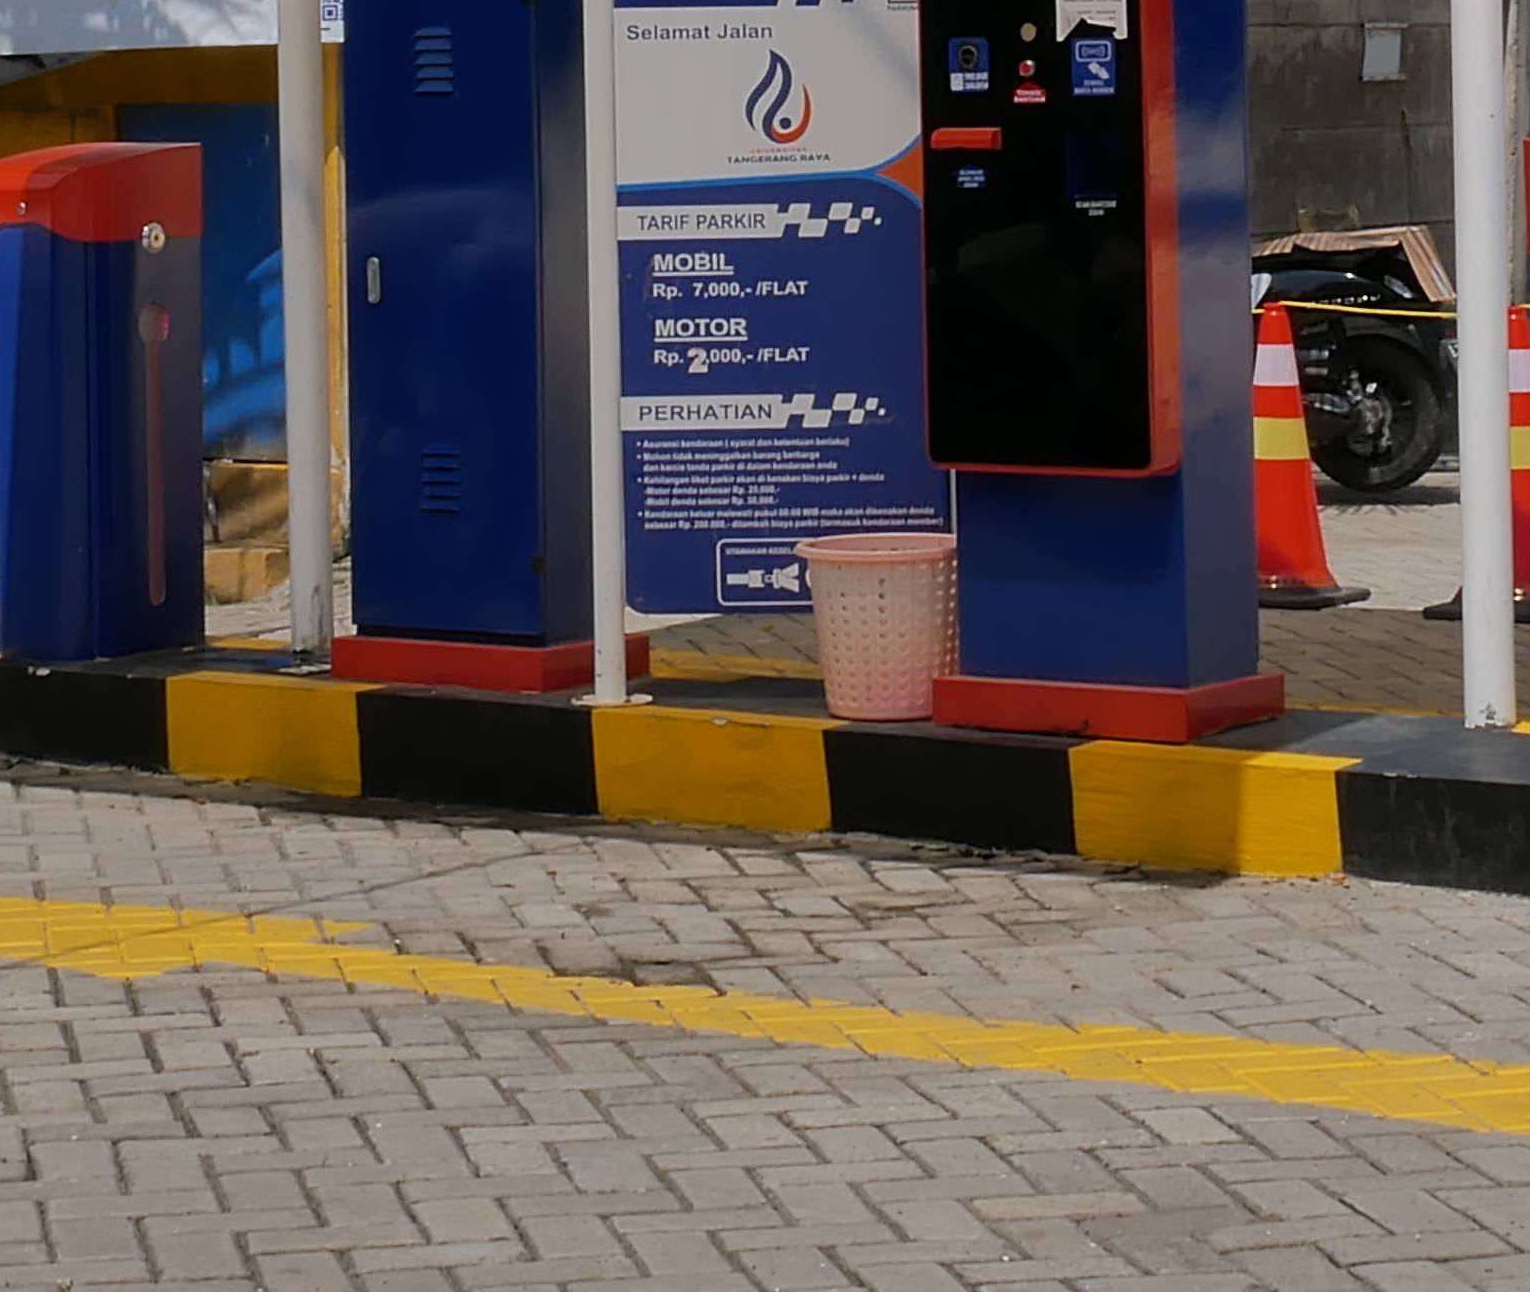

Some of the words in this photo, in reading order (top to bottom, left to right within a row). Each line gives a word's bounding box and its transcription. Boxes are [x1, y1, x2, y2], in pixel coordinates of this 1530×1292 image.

[626, 24, 710, 40] Selamat
[717, 23, 773, 39] Jalan
[727, 155, 797, 164] TANGERANG
[800, 154, 831, 162] RAYA
[637, 214, 690, 231] TARIF
[696, 213, 766, 229] PARKIR
[652, 252, 734, 273] MOBIL
[652, 282, 683, 301] Rp.
[692, 281, 752, 299] 7,000,-
[754, 280, 809, 297] /FLAT
[654, 318, 748, 339] MOTOR
[653, 349, 685, 367] Rp.
[756, 347, 810, 363] /FLAT
[638, 404, 772, 422] PERHATIAN
